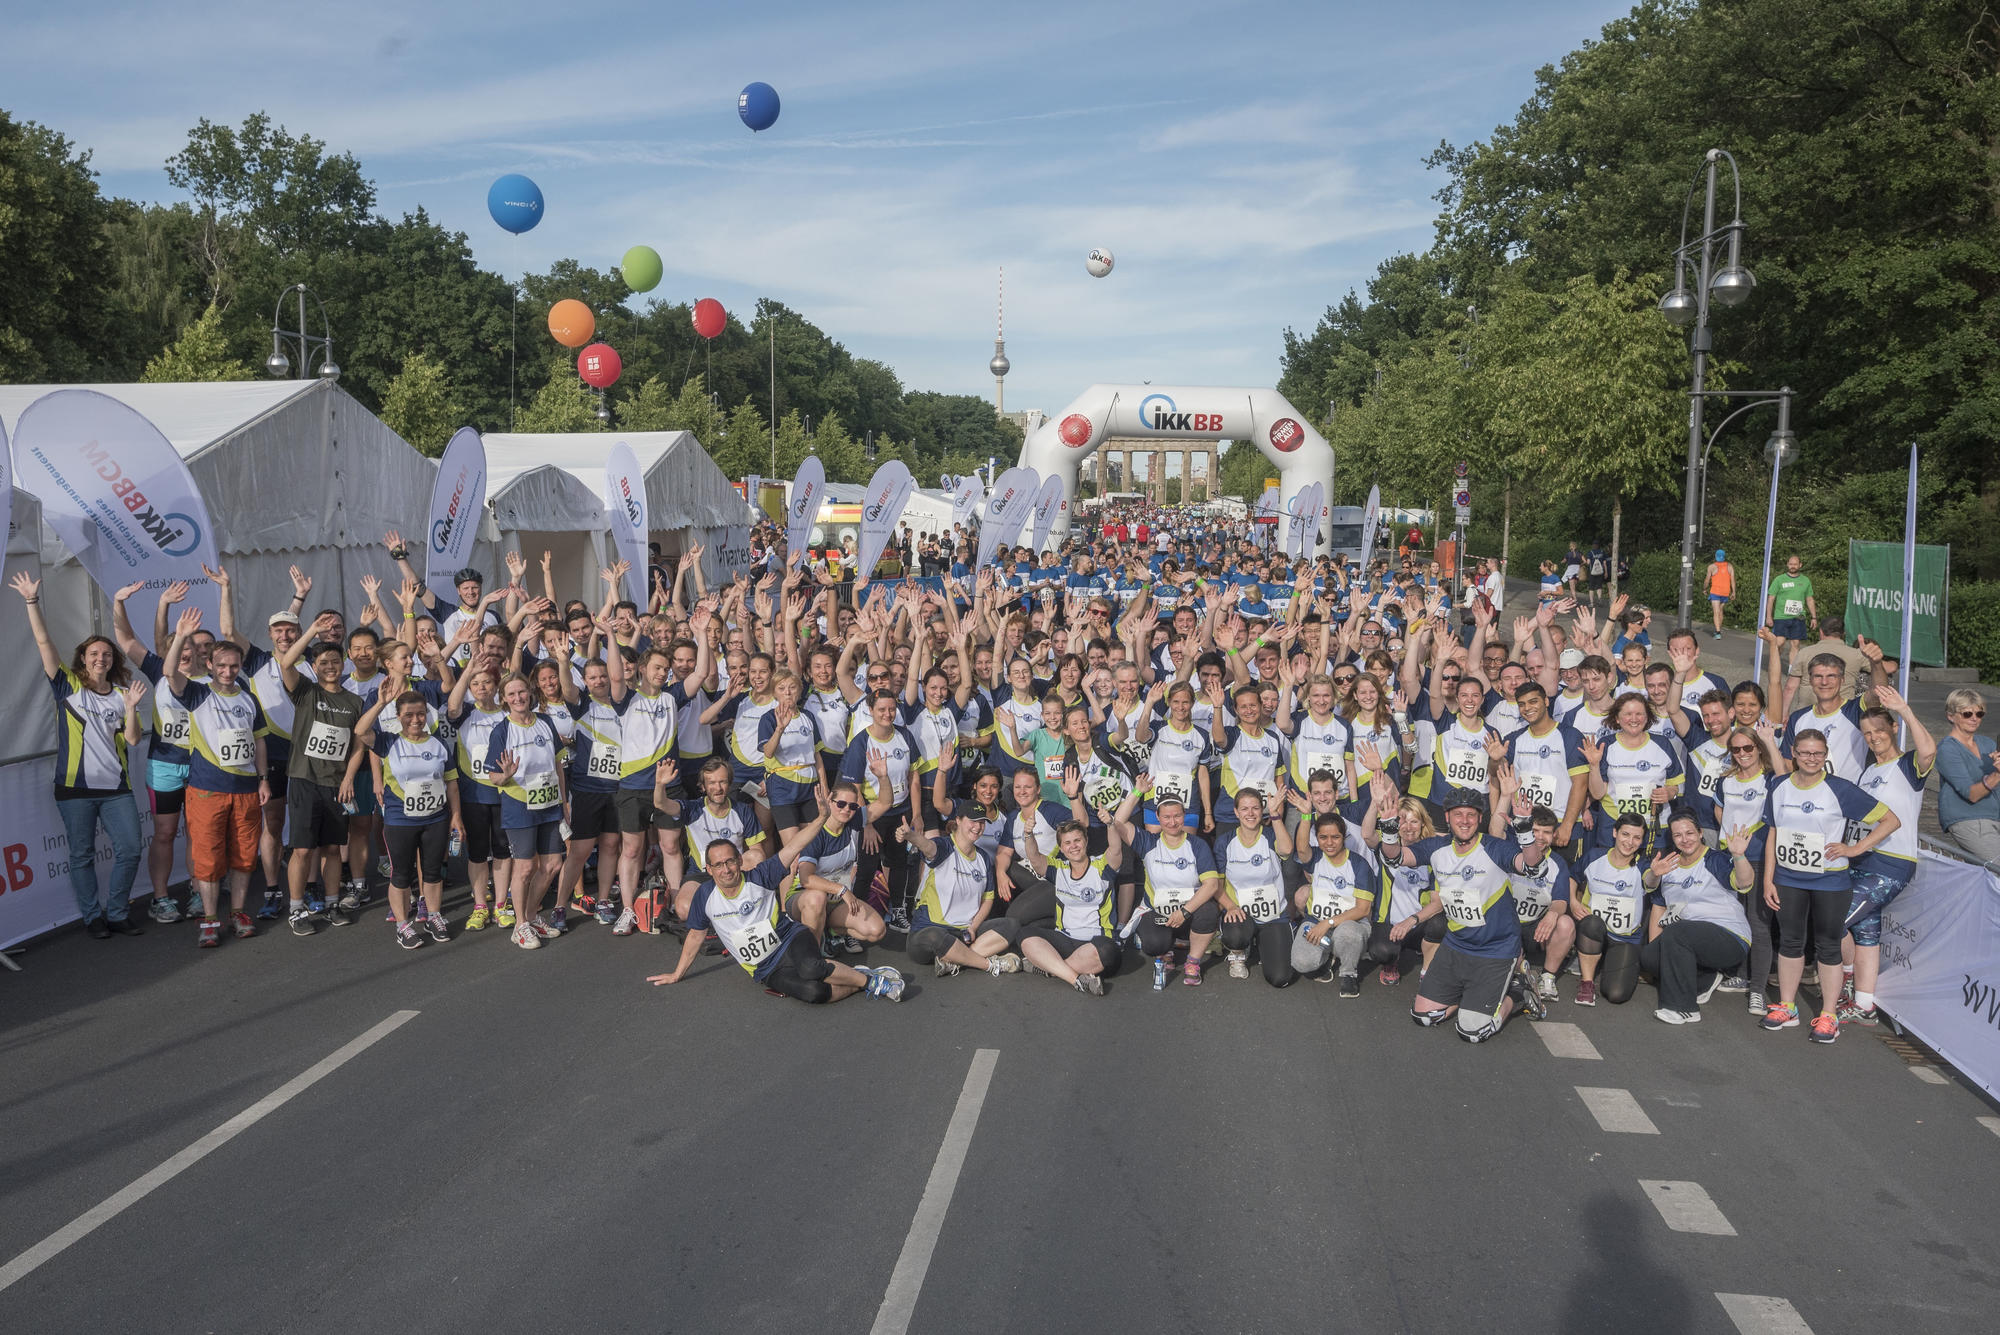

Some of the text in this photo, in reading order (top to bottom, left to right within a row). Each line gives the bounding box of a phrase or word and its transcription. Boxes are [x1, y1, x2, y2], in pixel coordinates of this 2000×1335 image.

[1272, 421, 1295, 443] FIRMEN
[220, 742, 256, 762] 9733
[307, 736, 347, 757] 9951
[1447, 763, 1485, 782] 9809
[405, 794, 445, 812] 9824
[528, 785, 559, 805] 2335
[1777, 845, 1822, 868] 9832
[1444, 904, 1482, 920] 10131
[739, 931, 778, 962] 9874
